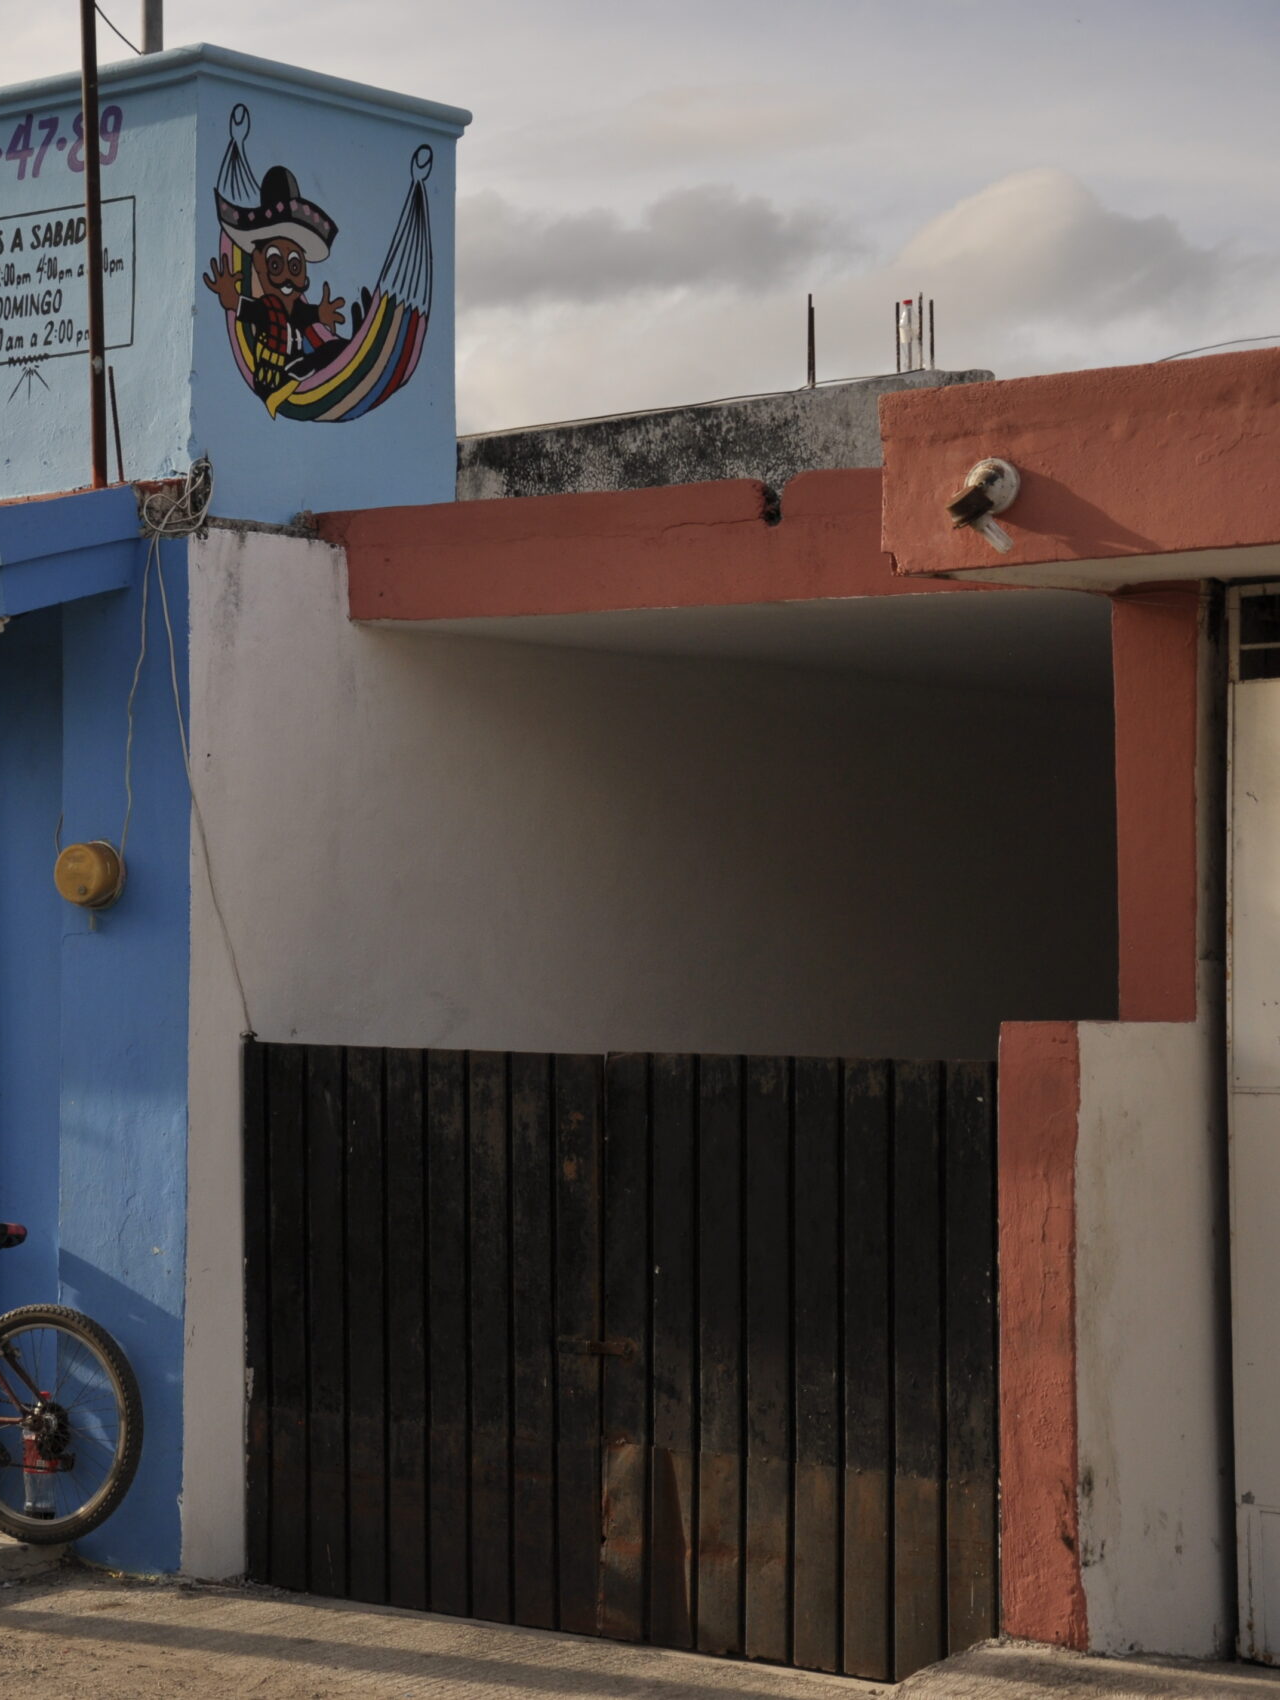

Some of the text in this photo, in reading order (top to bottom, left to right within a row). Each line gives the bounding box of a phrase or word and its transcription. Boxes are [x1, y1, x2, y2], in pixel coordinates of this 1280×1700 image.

[10, 228, 24, 253] A
[30, 217, 87, 250] SABAD
[30, 332, 38, 347] a
